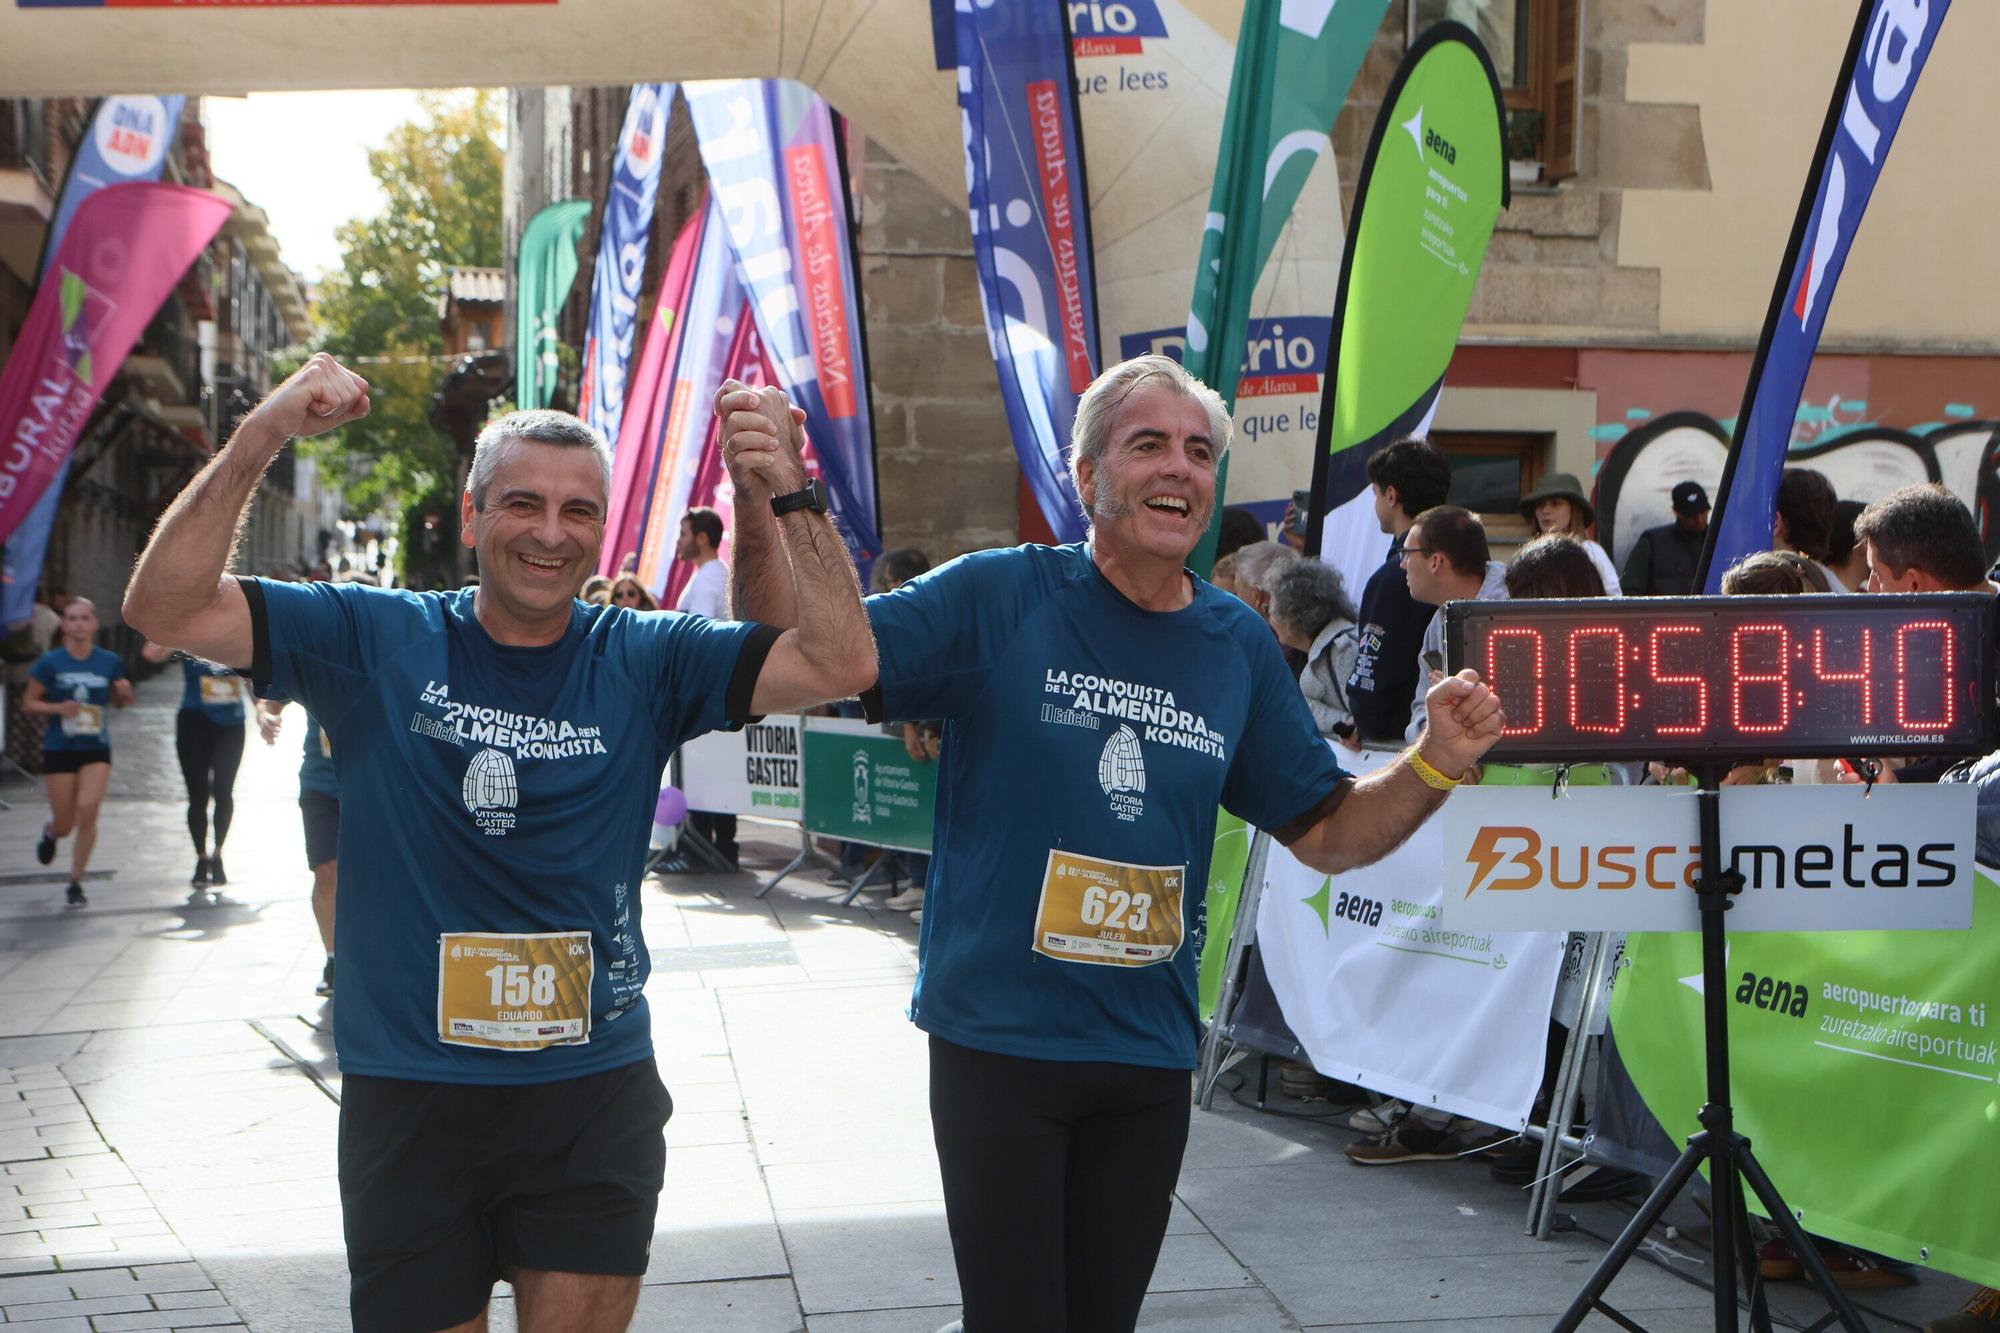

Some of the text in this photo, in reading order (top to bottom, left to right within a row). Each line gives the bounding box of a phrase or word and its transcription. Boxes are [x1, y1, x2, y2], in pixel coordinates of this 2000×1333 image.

[1077, 66, 1169, 95] ue lees
[1425, 128, 1457, 167] aena
[1257, 376, 1297, 396] Álava
[1243, 405, 1317, 442] que le
[425, 680, 449, 698] LA
[1046, 668, 1176, 708] LA CONQUISTA
[420, 692, 437, 704] DE
[437, 698, 451, 710] LA
[577, 726, 601, 738] REN
[1044, 683, 1225, 745] DE LA ALMENDRA REN
[1053, 708, 1100, 731] Edición
[517, 738, 608, 759] KONKISTA
[745, 725, 798, 755] VITORIA
[1144, 725, 1225, 761] KONKISTA
[1849, 734, 1945, 745] WWW.PIXELCOM.ES
[746, 757, 799, 788] GASTEIZ
[1110, 793, 1144, 807] VITORIA
[1110, 802, 1143, 816] GASTEIZ
[475, 810, 516, 819] VITORIA
[475, 819, 516, 828] GASTEIZ
[1117, 813, 1135, 822] 2025
[484, 828, 507, 836] 2025
[1164, 876, 1179, 887] 10K
[1080, 885, 1153, 932] 623
[1335, 891, 1383, 928] aena
[1098, 931, 1127, 941] JULEN
[1421, 927, 1495, 953] aireportuak
[568, 943, 585, 956] 10K
[485, 964, 556, 1007] 158
[1735, 972, 1809, 1019] aena
[497, 1010, 543, 1021] EDUARDO
[1823, 981, 1986, 1028] aeropuertos para ti
[1820, 1014, 1998, 1066] zuretzako aireportuak
